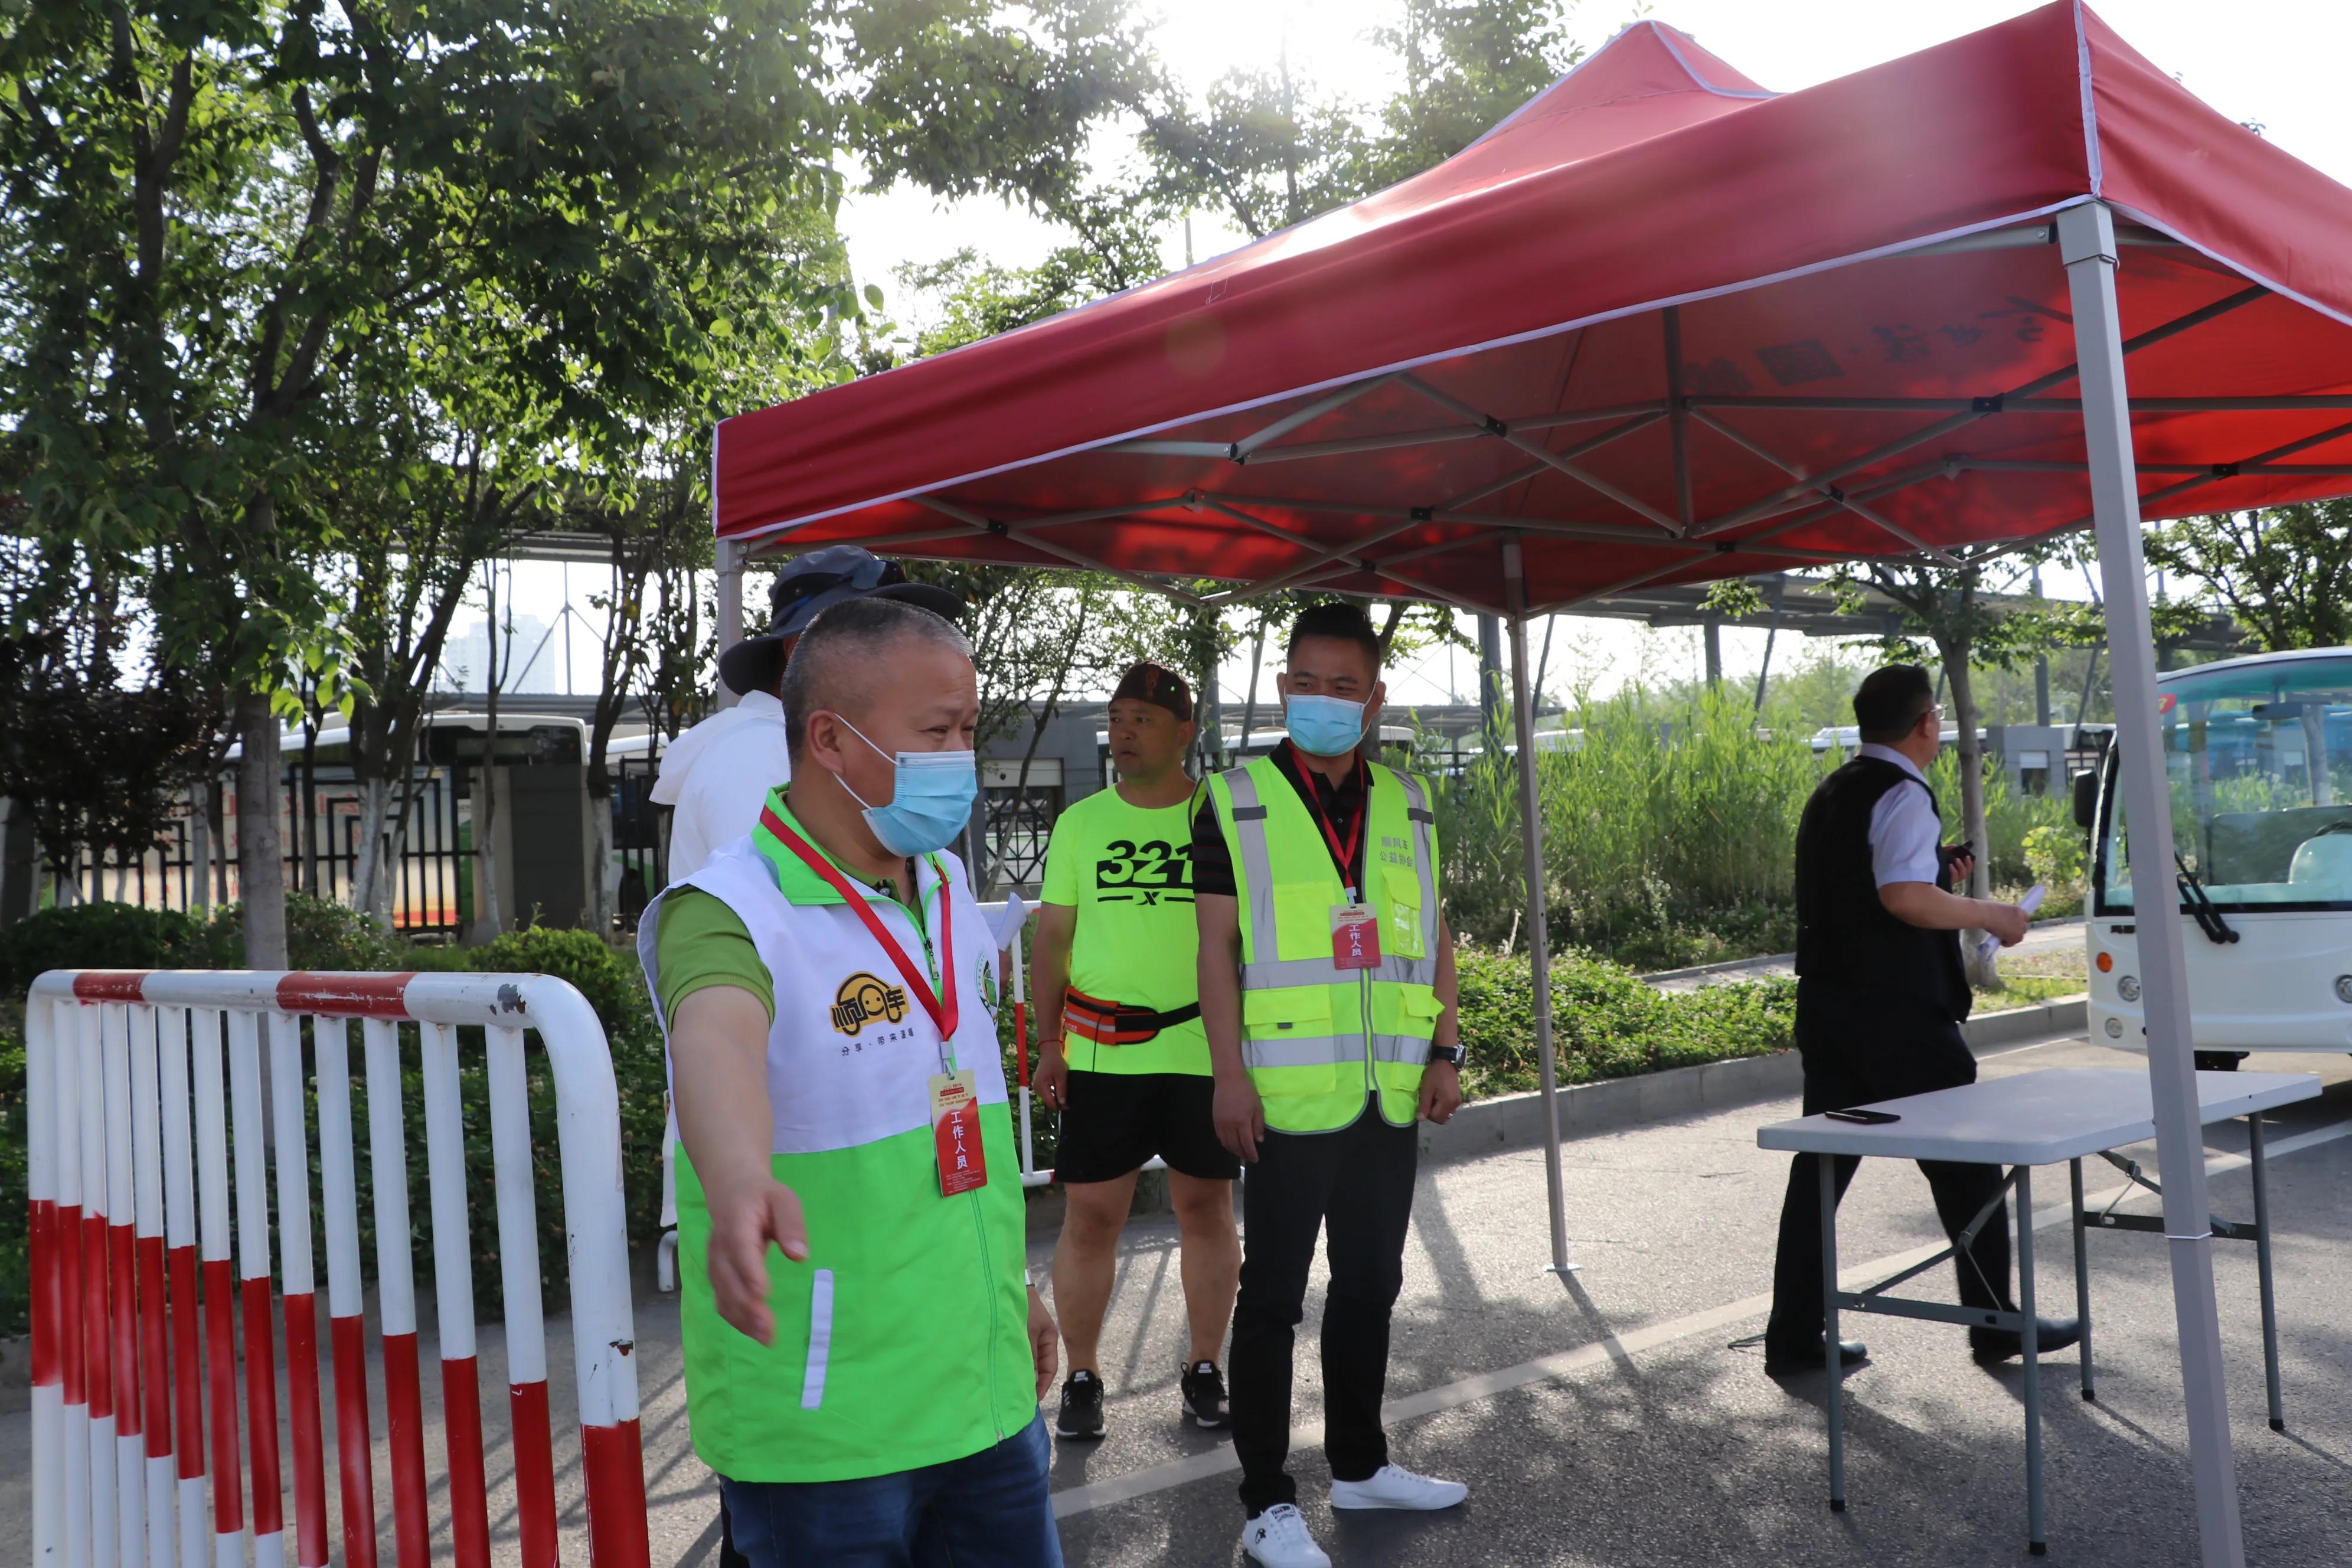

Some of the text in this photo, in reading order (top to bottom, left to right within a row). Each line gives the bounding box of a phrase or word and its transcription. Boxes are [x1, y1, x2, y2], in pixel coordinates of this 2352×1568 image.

[1099, 839, 1193, 884] 321
[1348, 925, 1363, 957] 工作人员
[950, 1110, 968, 1170] 工作人员
